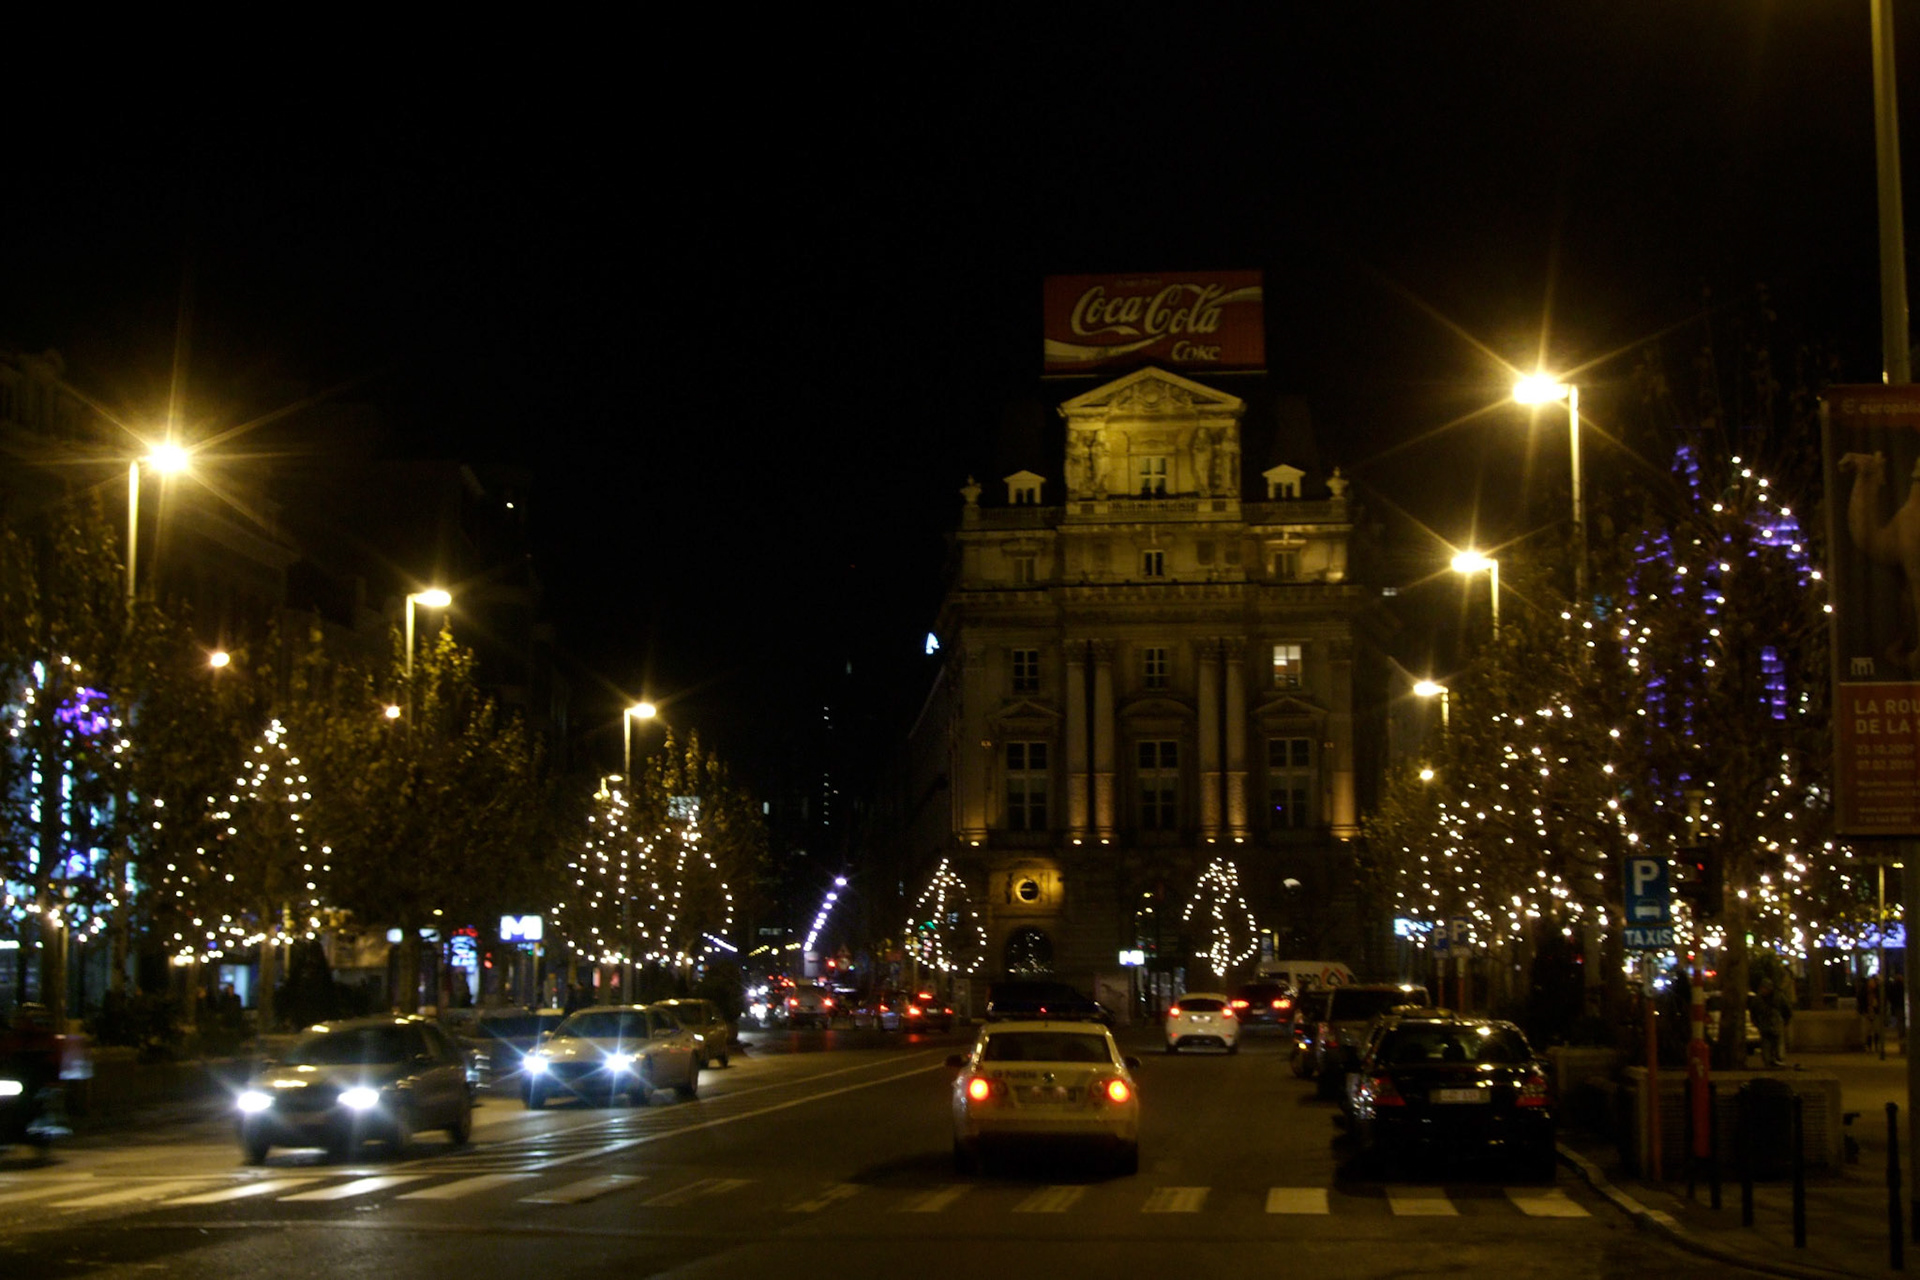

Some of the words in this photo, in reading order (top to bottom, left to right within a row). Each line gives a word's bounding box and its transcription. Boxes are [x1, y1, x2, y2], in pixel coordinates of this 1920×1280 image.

[1171, 340, 1221, 362] Coke
[1854, 699, 1879, 715] LA
[1855, 719, 1881, 735] DE
[1887, 719, 1911, 734] LA
[1633, 859, 1660, 897] P
[1433, 927, 1448, 947] P
[1452, 919, 1468, 942] P
[1624, 929, 1673, 946] TAXIS
